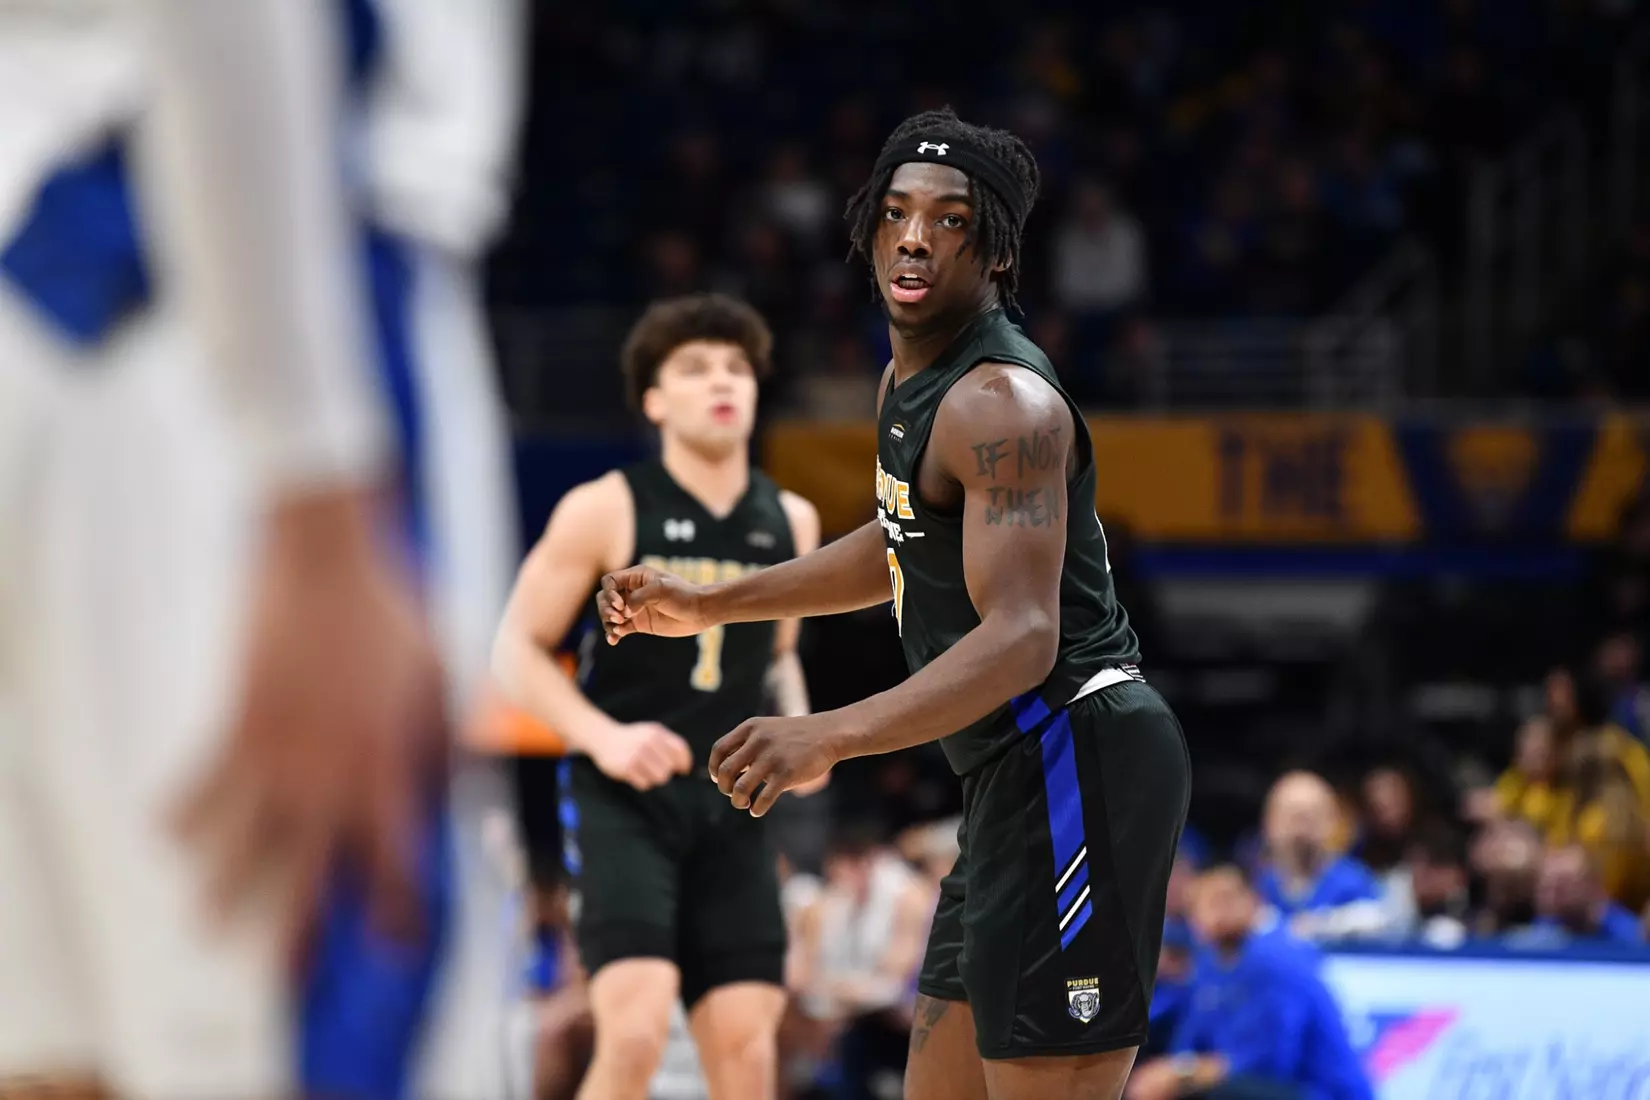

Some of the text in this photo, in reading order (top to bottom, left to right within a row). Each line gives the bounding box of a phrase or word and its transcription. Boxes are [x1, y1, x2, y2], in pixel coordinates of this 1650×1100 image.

[970, 424, 1062, 481] IF NOT
[1067, 977, 1099, 988] PURDUE
